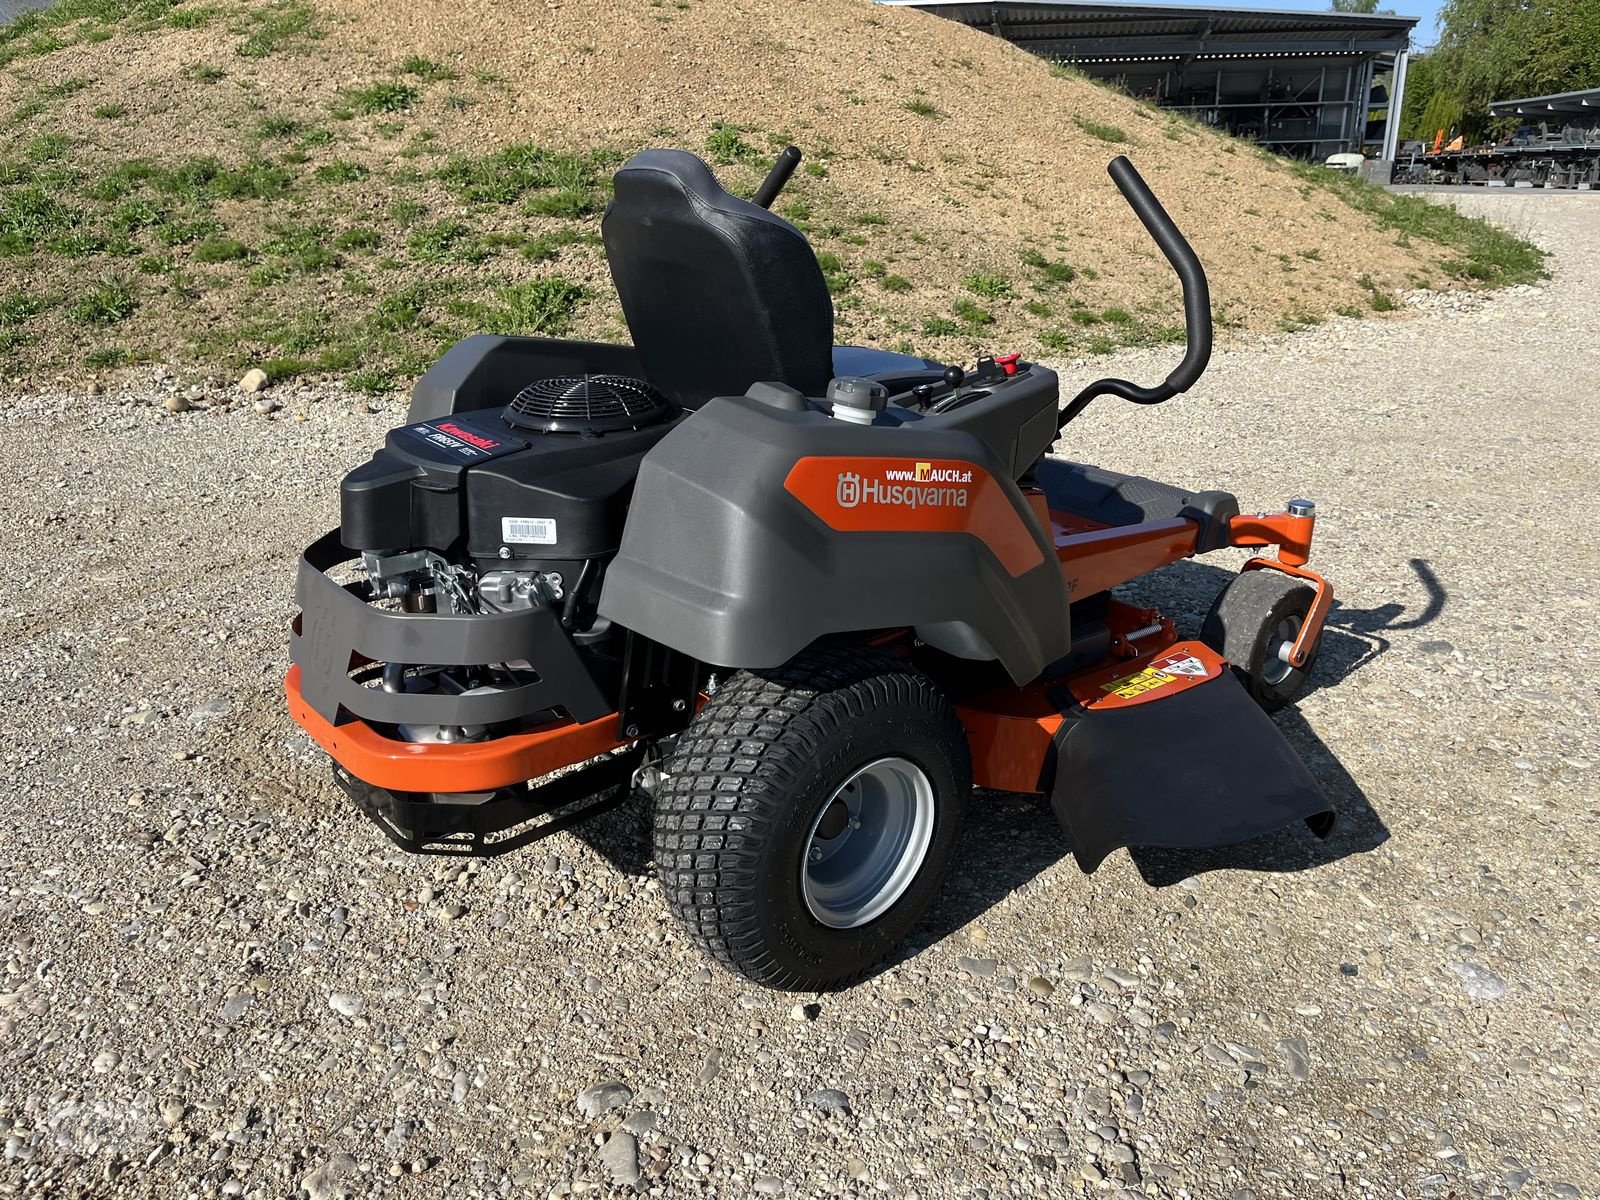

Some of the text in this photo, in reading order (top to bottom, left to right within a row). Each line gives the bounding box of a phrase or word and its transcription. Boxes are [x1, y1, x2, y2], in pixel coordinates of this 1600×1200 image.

[436, 422, 500, 449] Kawasaki
[886, 467, 972, 483] www.MAUCH.at
[862, 478, 967, 509] Husqvarna
